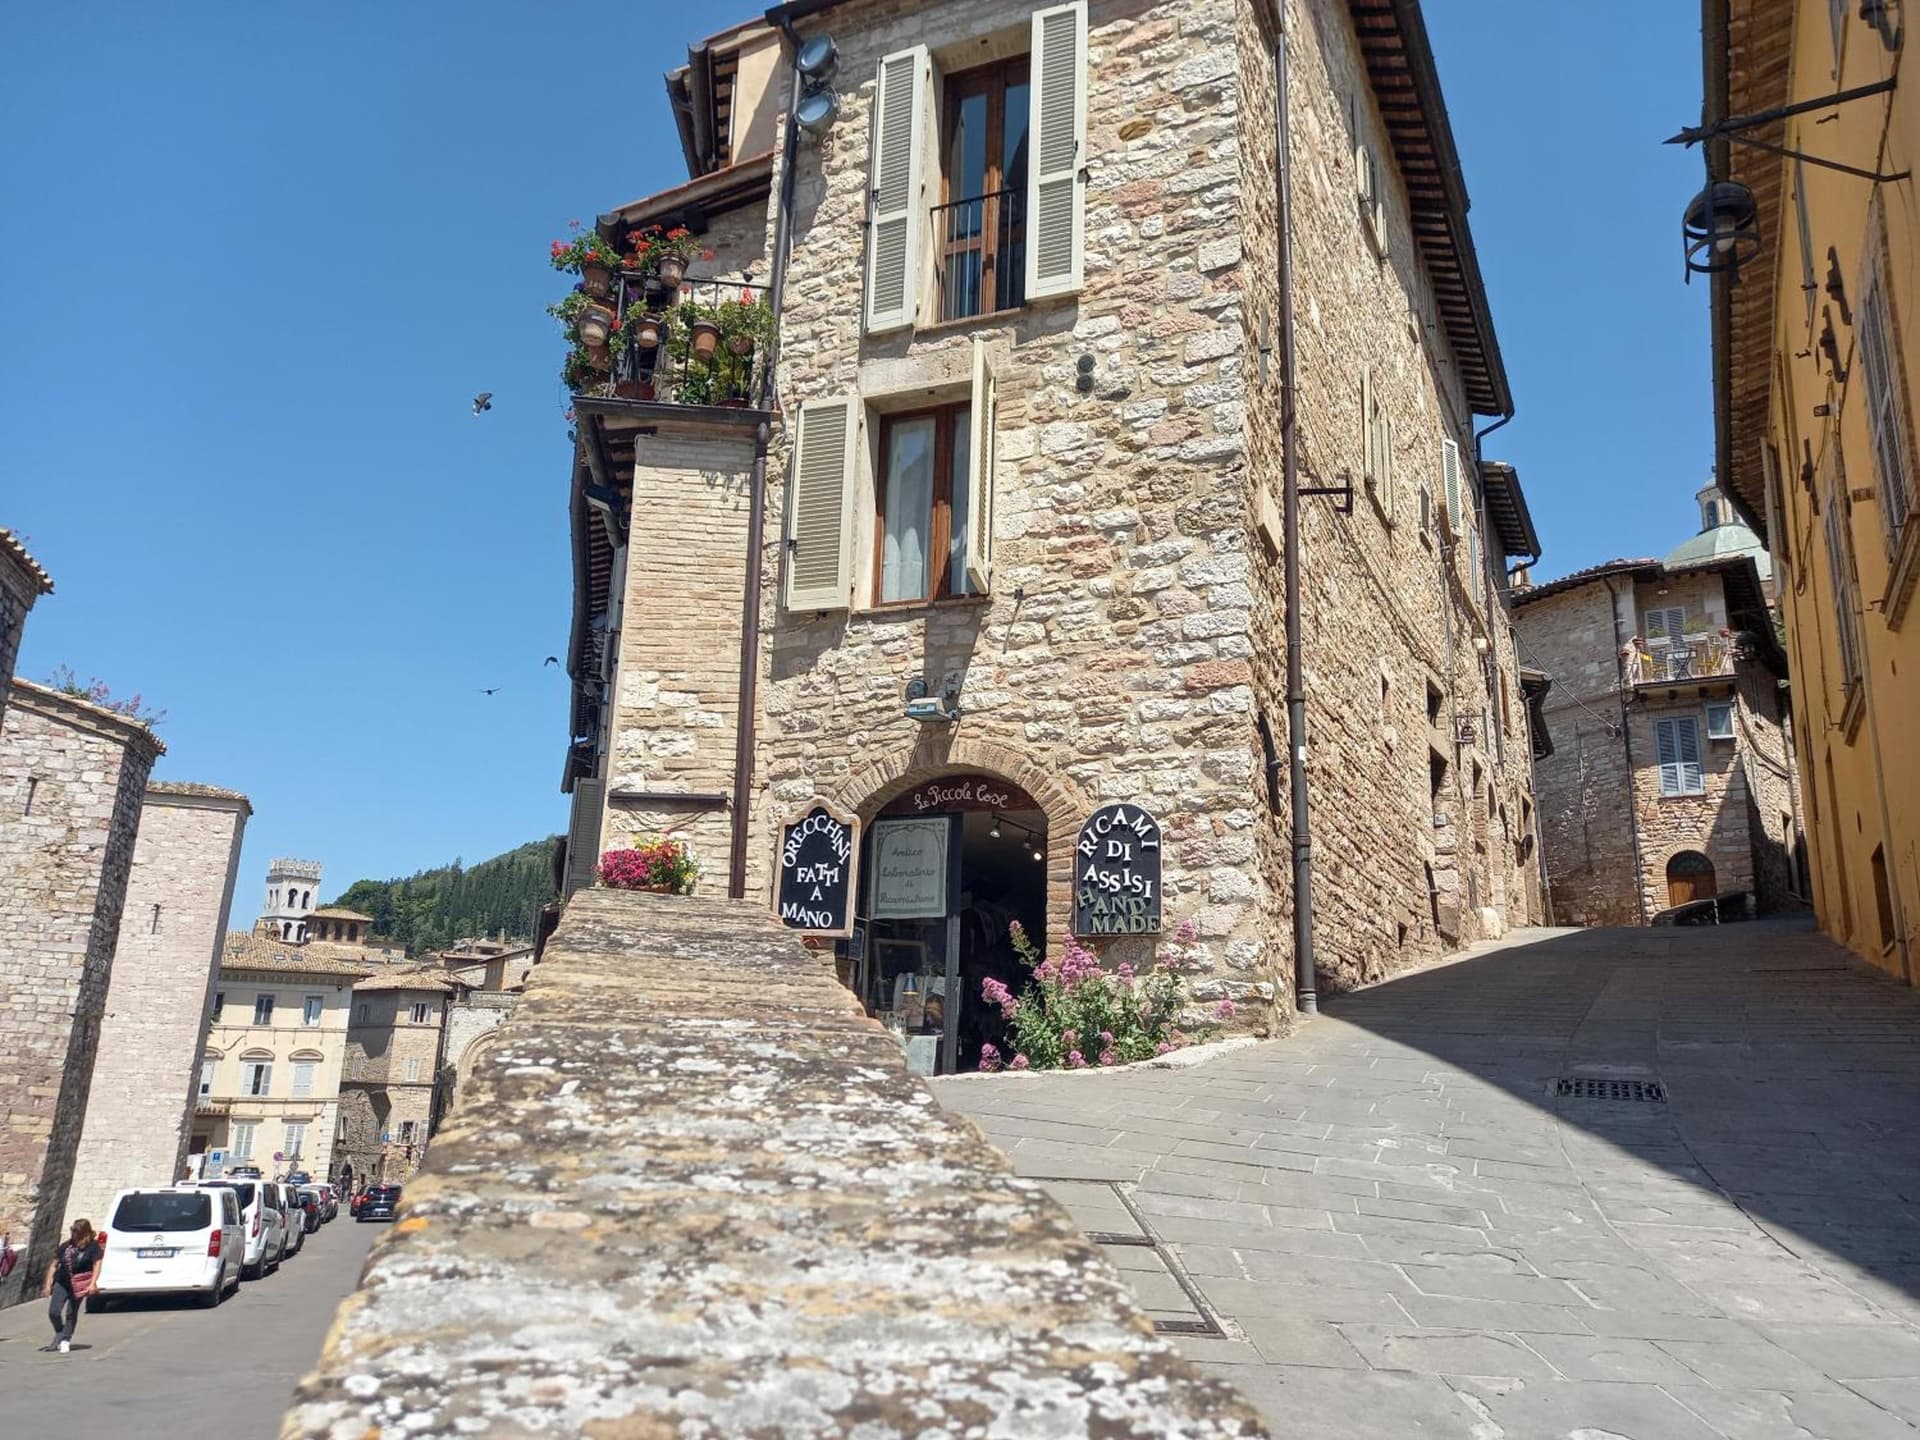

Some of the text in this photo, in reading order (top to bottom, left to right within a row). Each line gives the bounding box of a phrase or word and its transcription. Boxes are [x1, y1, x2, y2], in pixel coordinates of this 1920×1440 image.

[914, 782, 1008, 810] Le Piccole Cose
[782, 814, 851, 867] ORECCHINI
[1078, 807, 1159, 858] RICAMI
[1106, 840, 1132, 861] DI
[796, 862, 840, 887] FATTI
[1083, 863, 1153, 898] ASSISI
[810, 884, 823, 901] A
[1078, 887, 1147, 916] HAND
[782, 902, 832, 928] MANO
[1090, 915, 1161, 934] MADE
